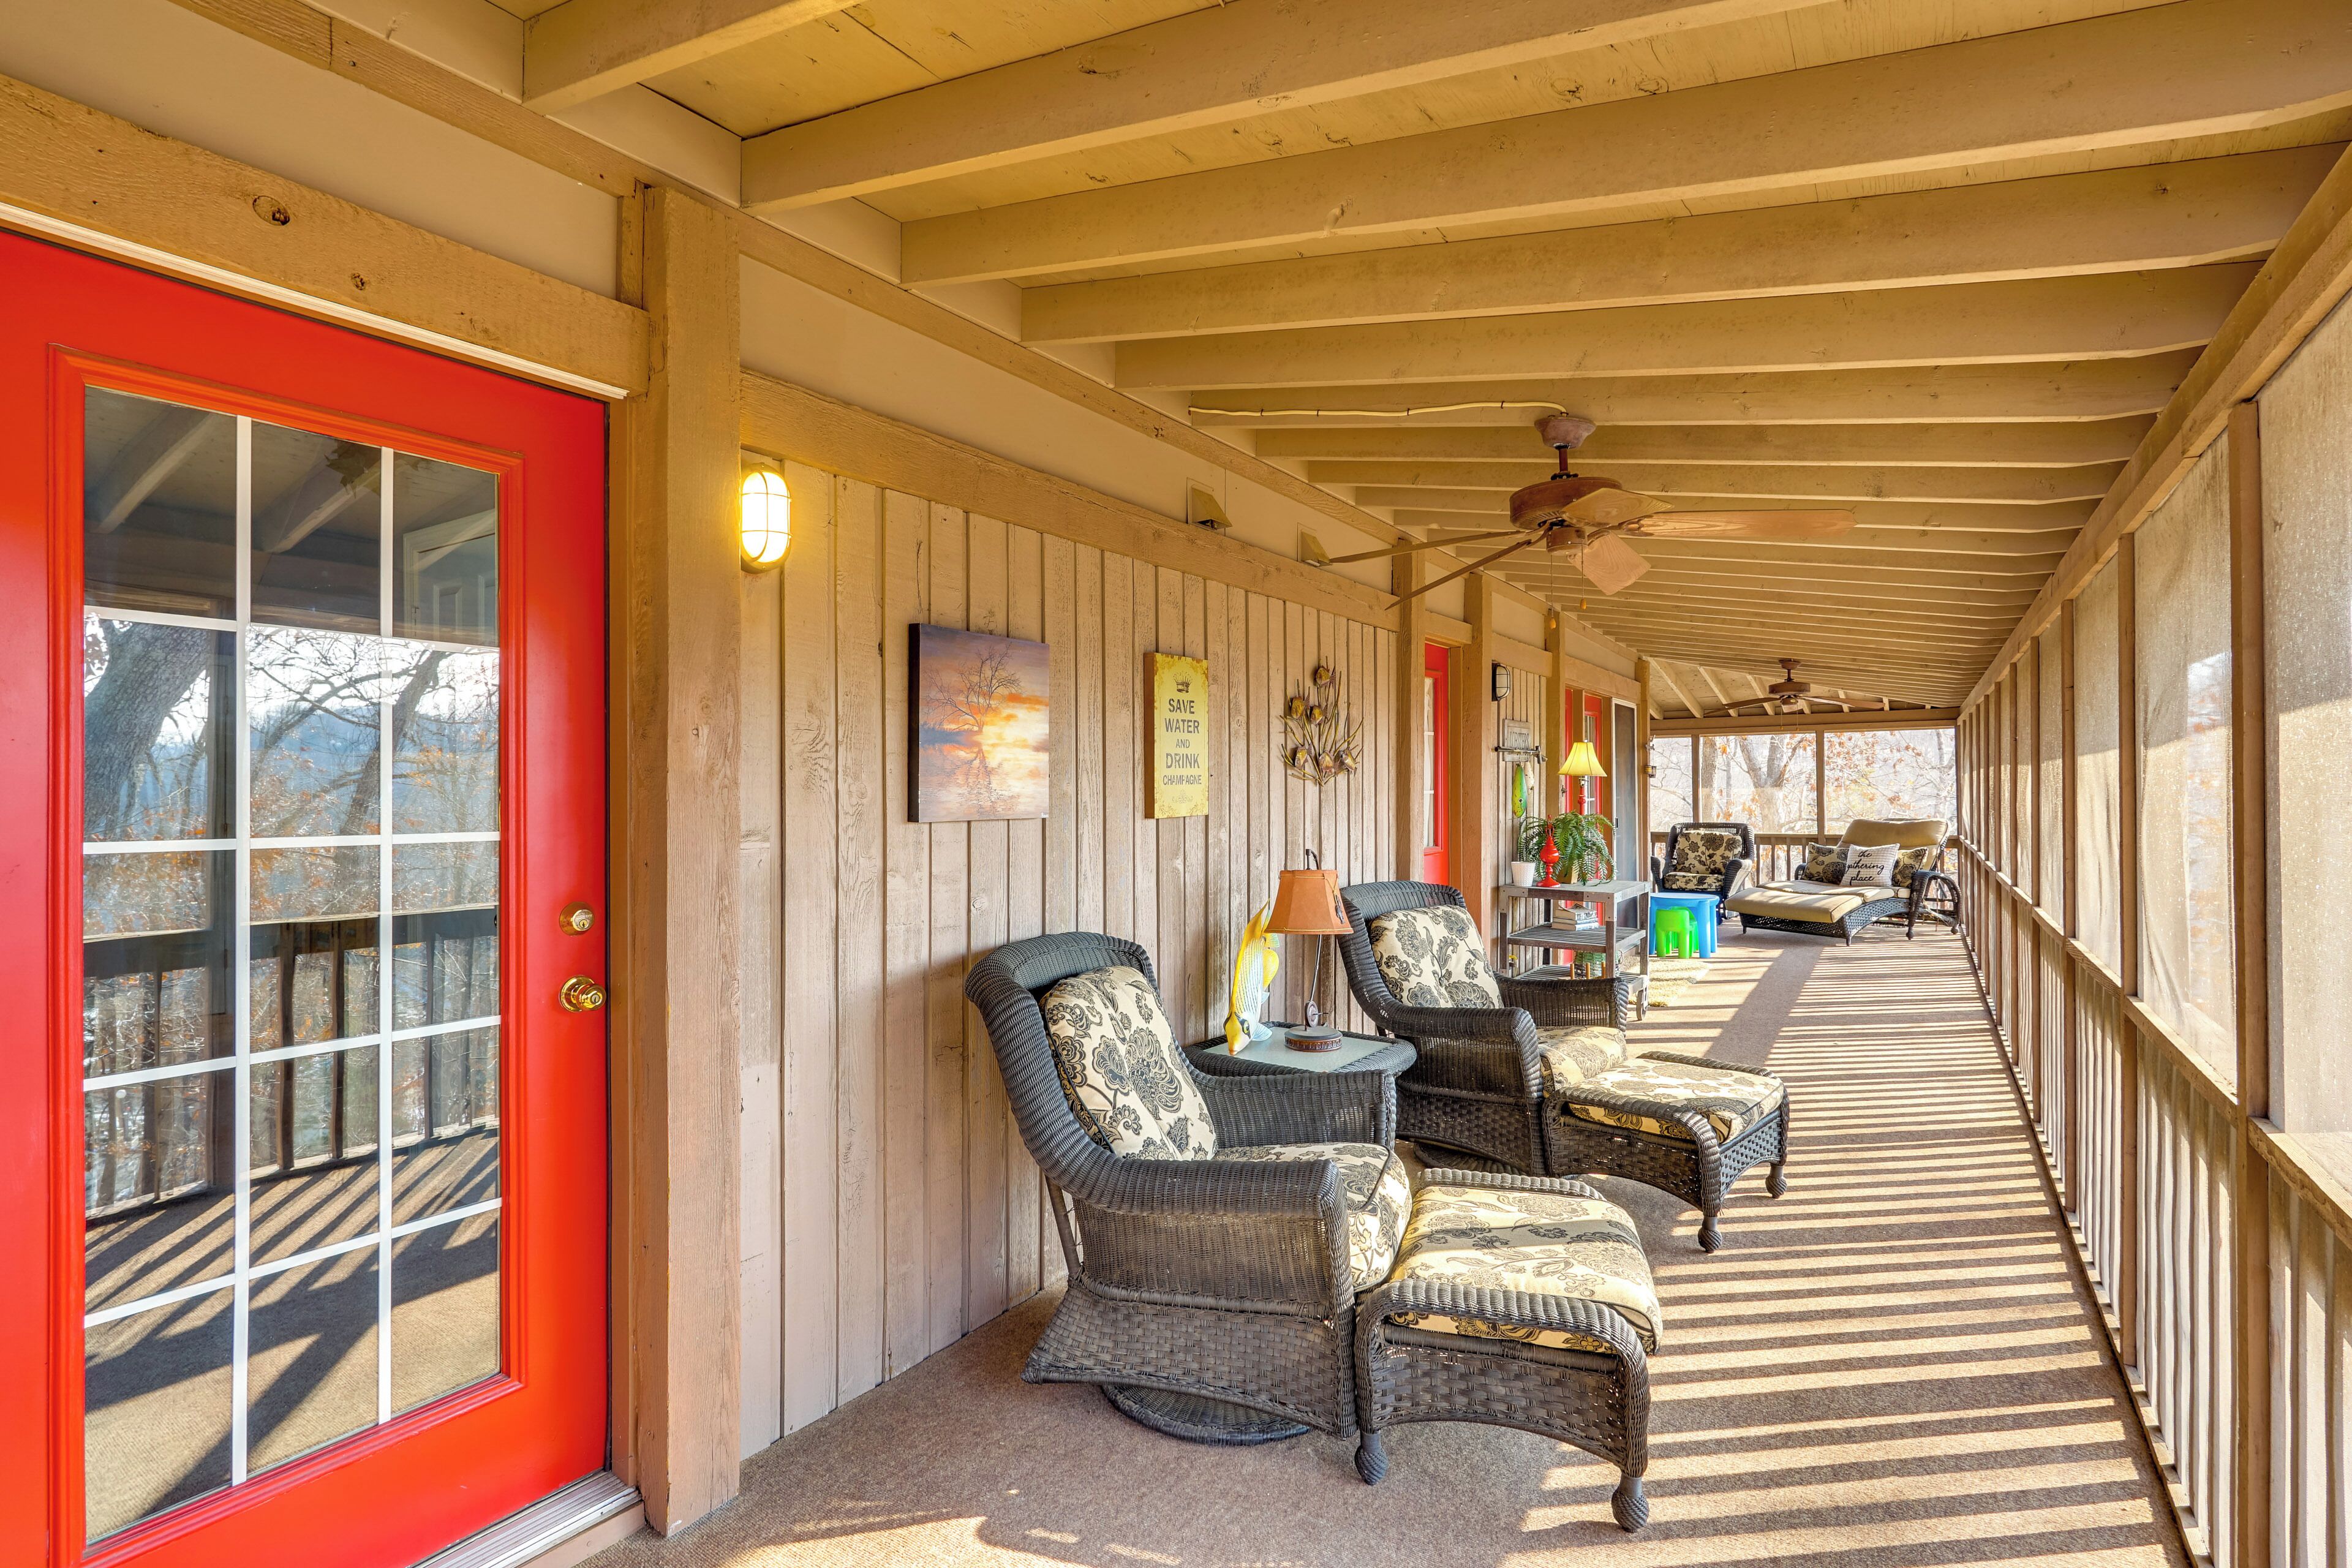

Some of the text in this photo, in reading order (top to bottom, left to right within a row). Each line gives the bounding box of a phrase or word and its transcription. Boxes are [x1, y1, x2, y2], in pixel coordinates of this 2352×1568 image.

[1168, 698, 1195, 714] SAVE
[1164, 718, 1200, 734] WATER
[1176, 739, 1190, 748] AND
[1166, 753, 1200, 769] DRINK
[1163, 774, 1202, 785] CHAMPAGNE
[1850, 870, 1875, 886] place
